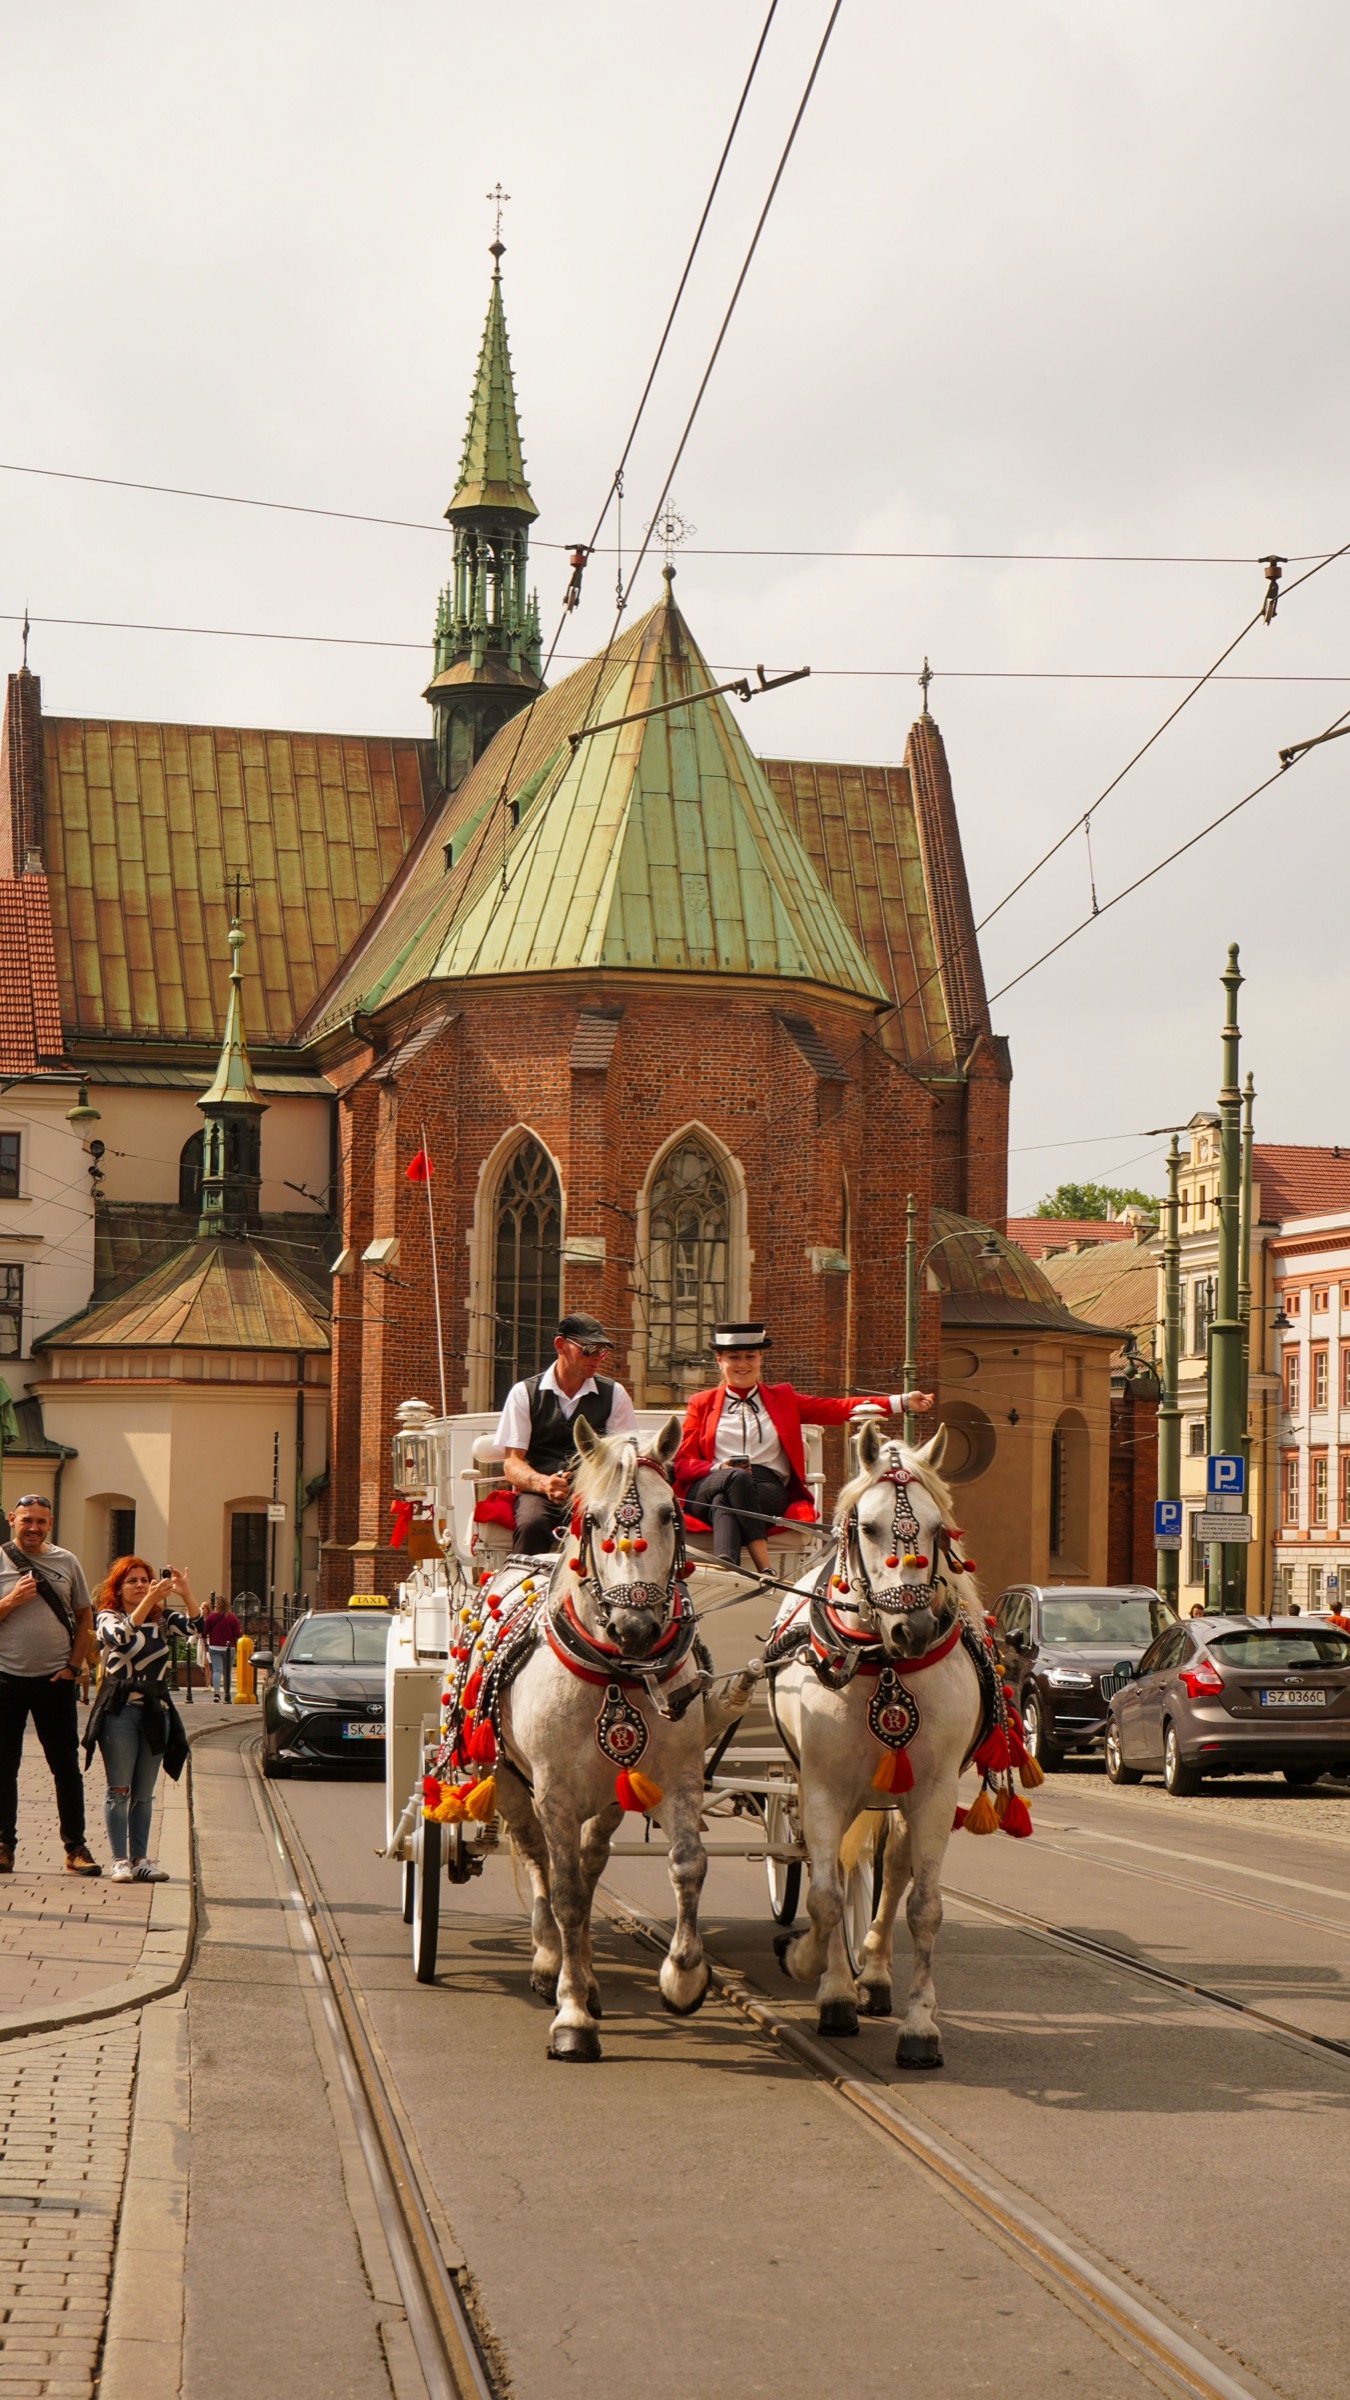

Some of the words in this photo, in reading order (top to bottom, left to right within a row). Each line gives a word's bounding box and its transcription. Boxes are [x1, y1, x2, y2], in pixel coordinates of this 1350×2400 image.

[1215, 1460, 1236, 1489] P
[1161, 1504, 1176, 1525] P
[1329, 1577, 1336, 1586] P
[1268, 1692, 1285, 1702] SZ
[1289, 1692, 1323, 1702] 0366C
[350, 1724, 364, 1735] SK
